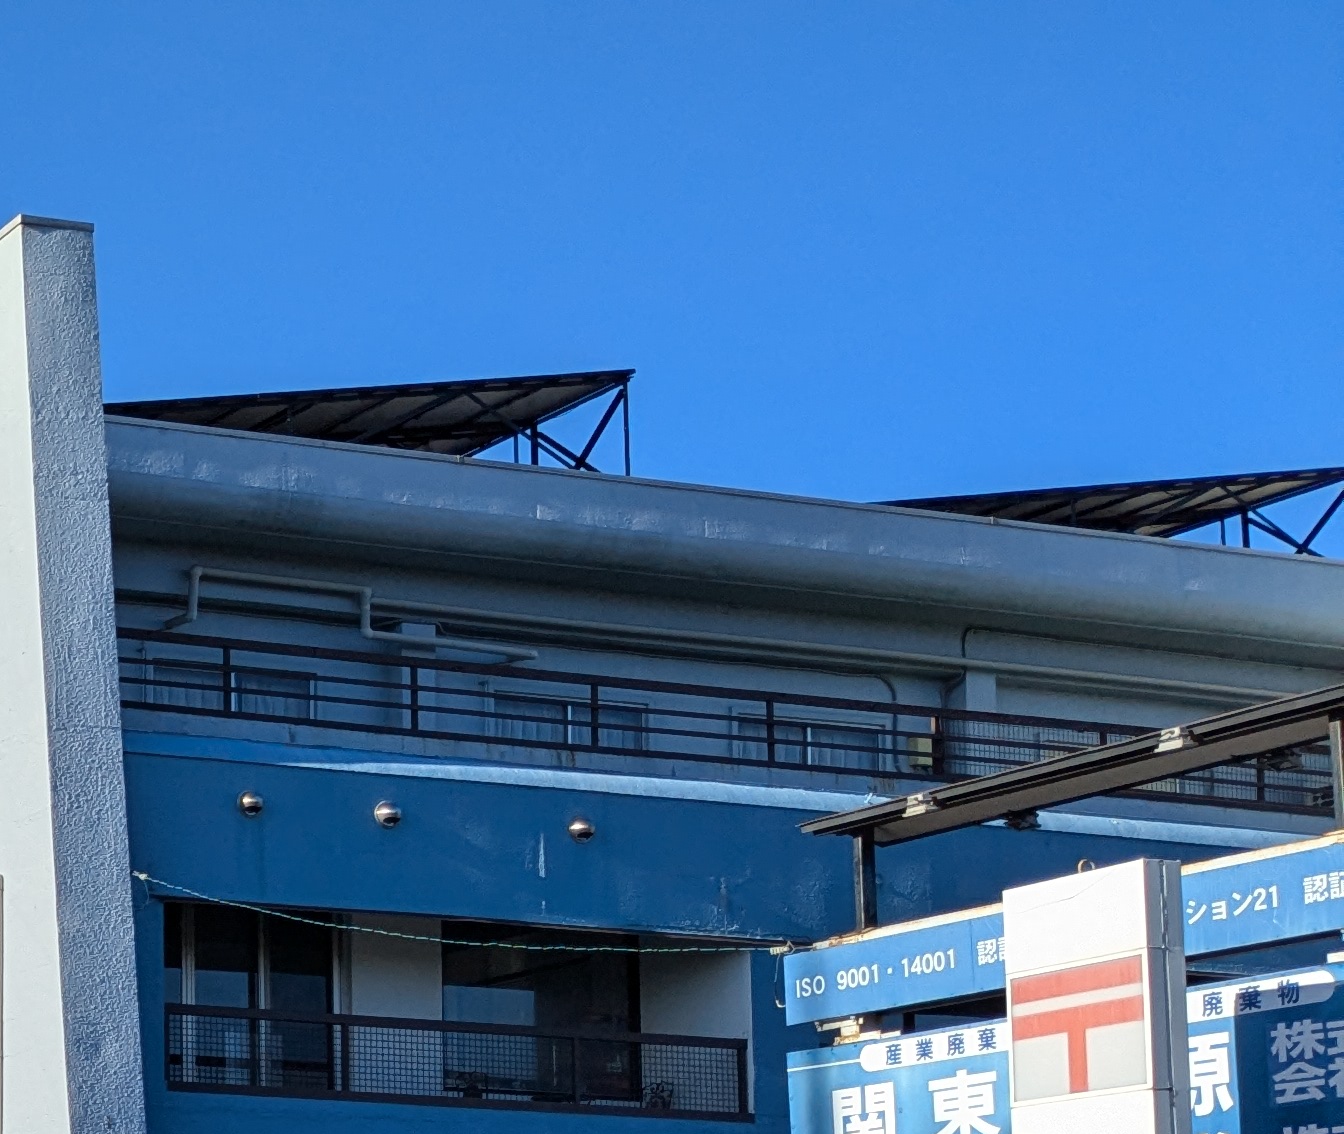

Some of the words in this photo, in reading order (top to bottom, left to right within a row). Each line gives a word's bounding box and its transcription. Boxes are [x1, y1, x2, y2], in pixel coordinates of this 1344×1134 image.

[795, 975, 825, 998] ISO
[1202, 979, 1300, 1018] 廃棄物
[885, 1027, 997, 1066] 産業廃棄
